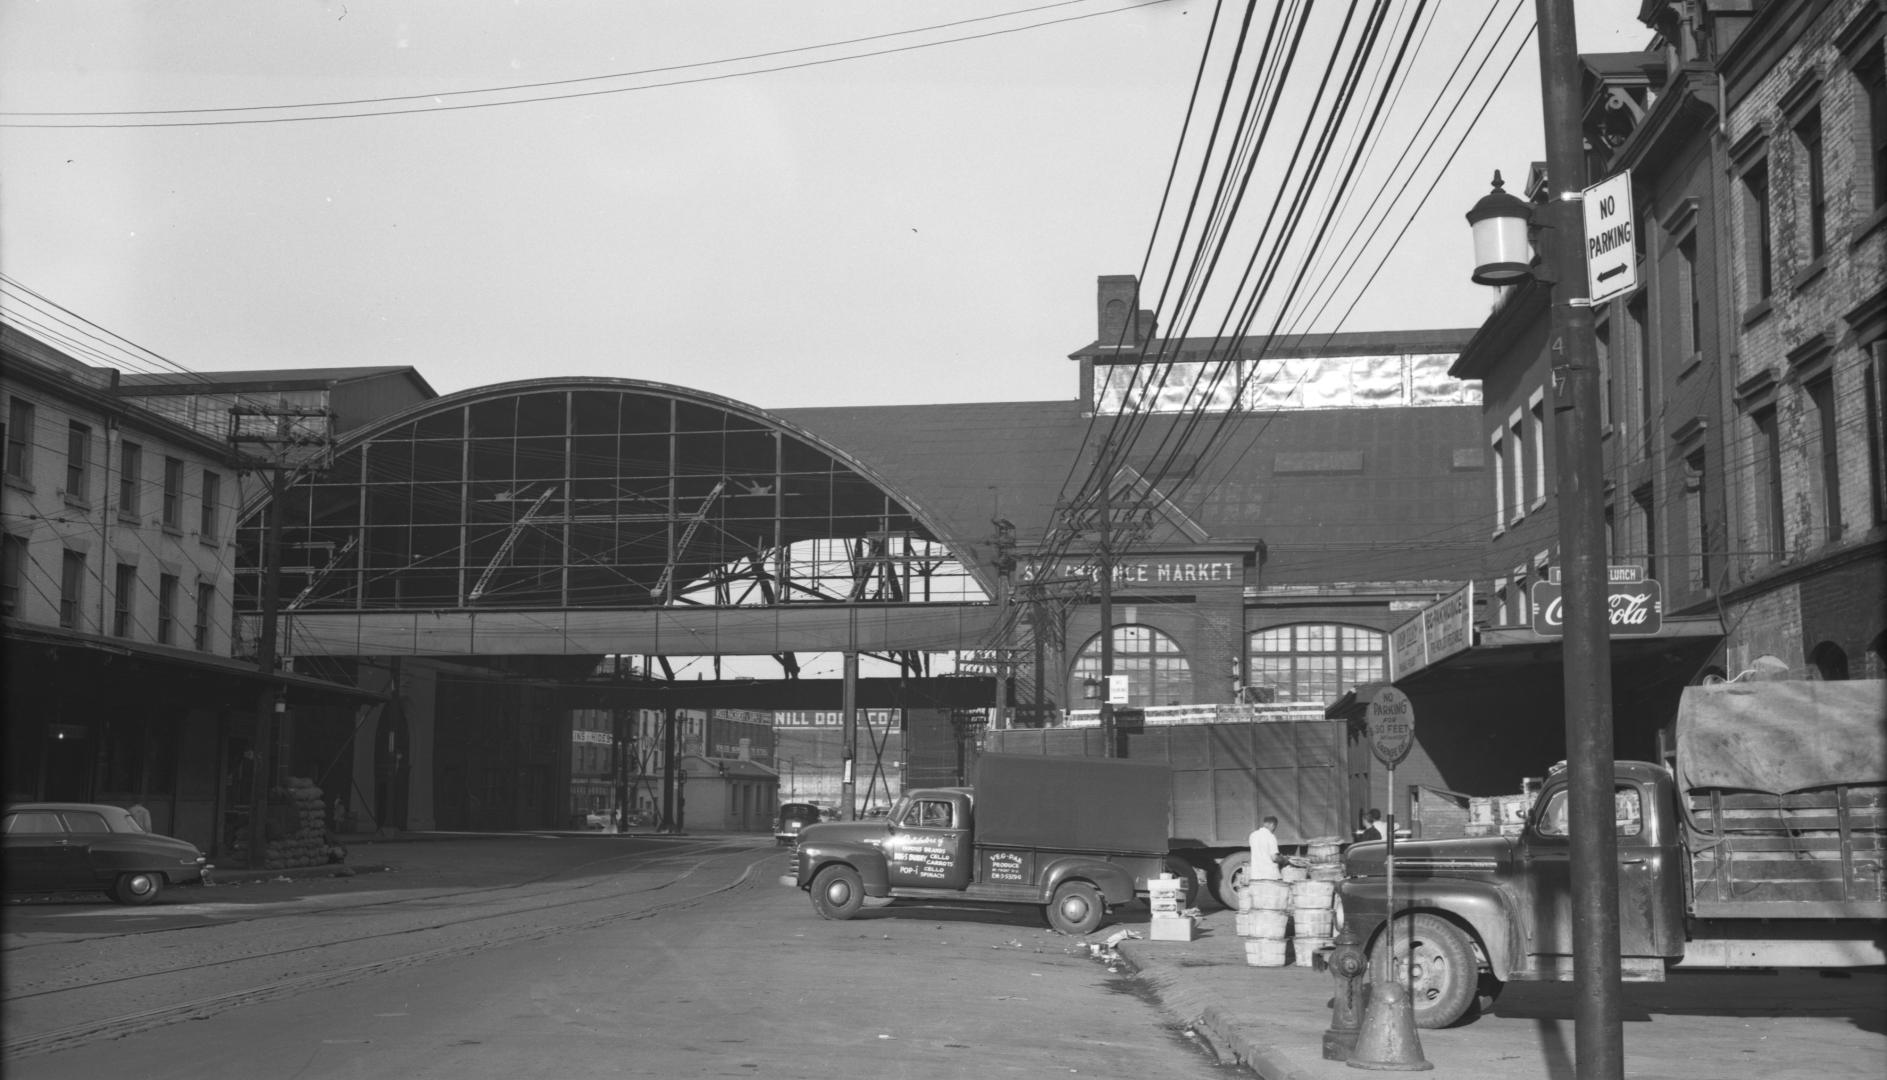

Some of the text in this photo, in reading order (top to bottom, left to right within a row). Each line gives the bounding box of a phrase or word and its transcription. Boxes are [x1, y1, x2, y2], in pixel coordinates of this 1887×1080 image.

[1600, 195, 1615, 220] NO
[1589, 221, 1631, 259] PARKING
[1157, 562, 1233, 581] MARKET
[1609, 569, 1636, 581] LUNCH
[1383, 692, 1393, 703] NO
[1374, 699, 1407, 716] PARKING
[1387, 724, 1408, 733] FEET
